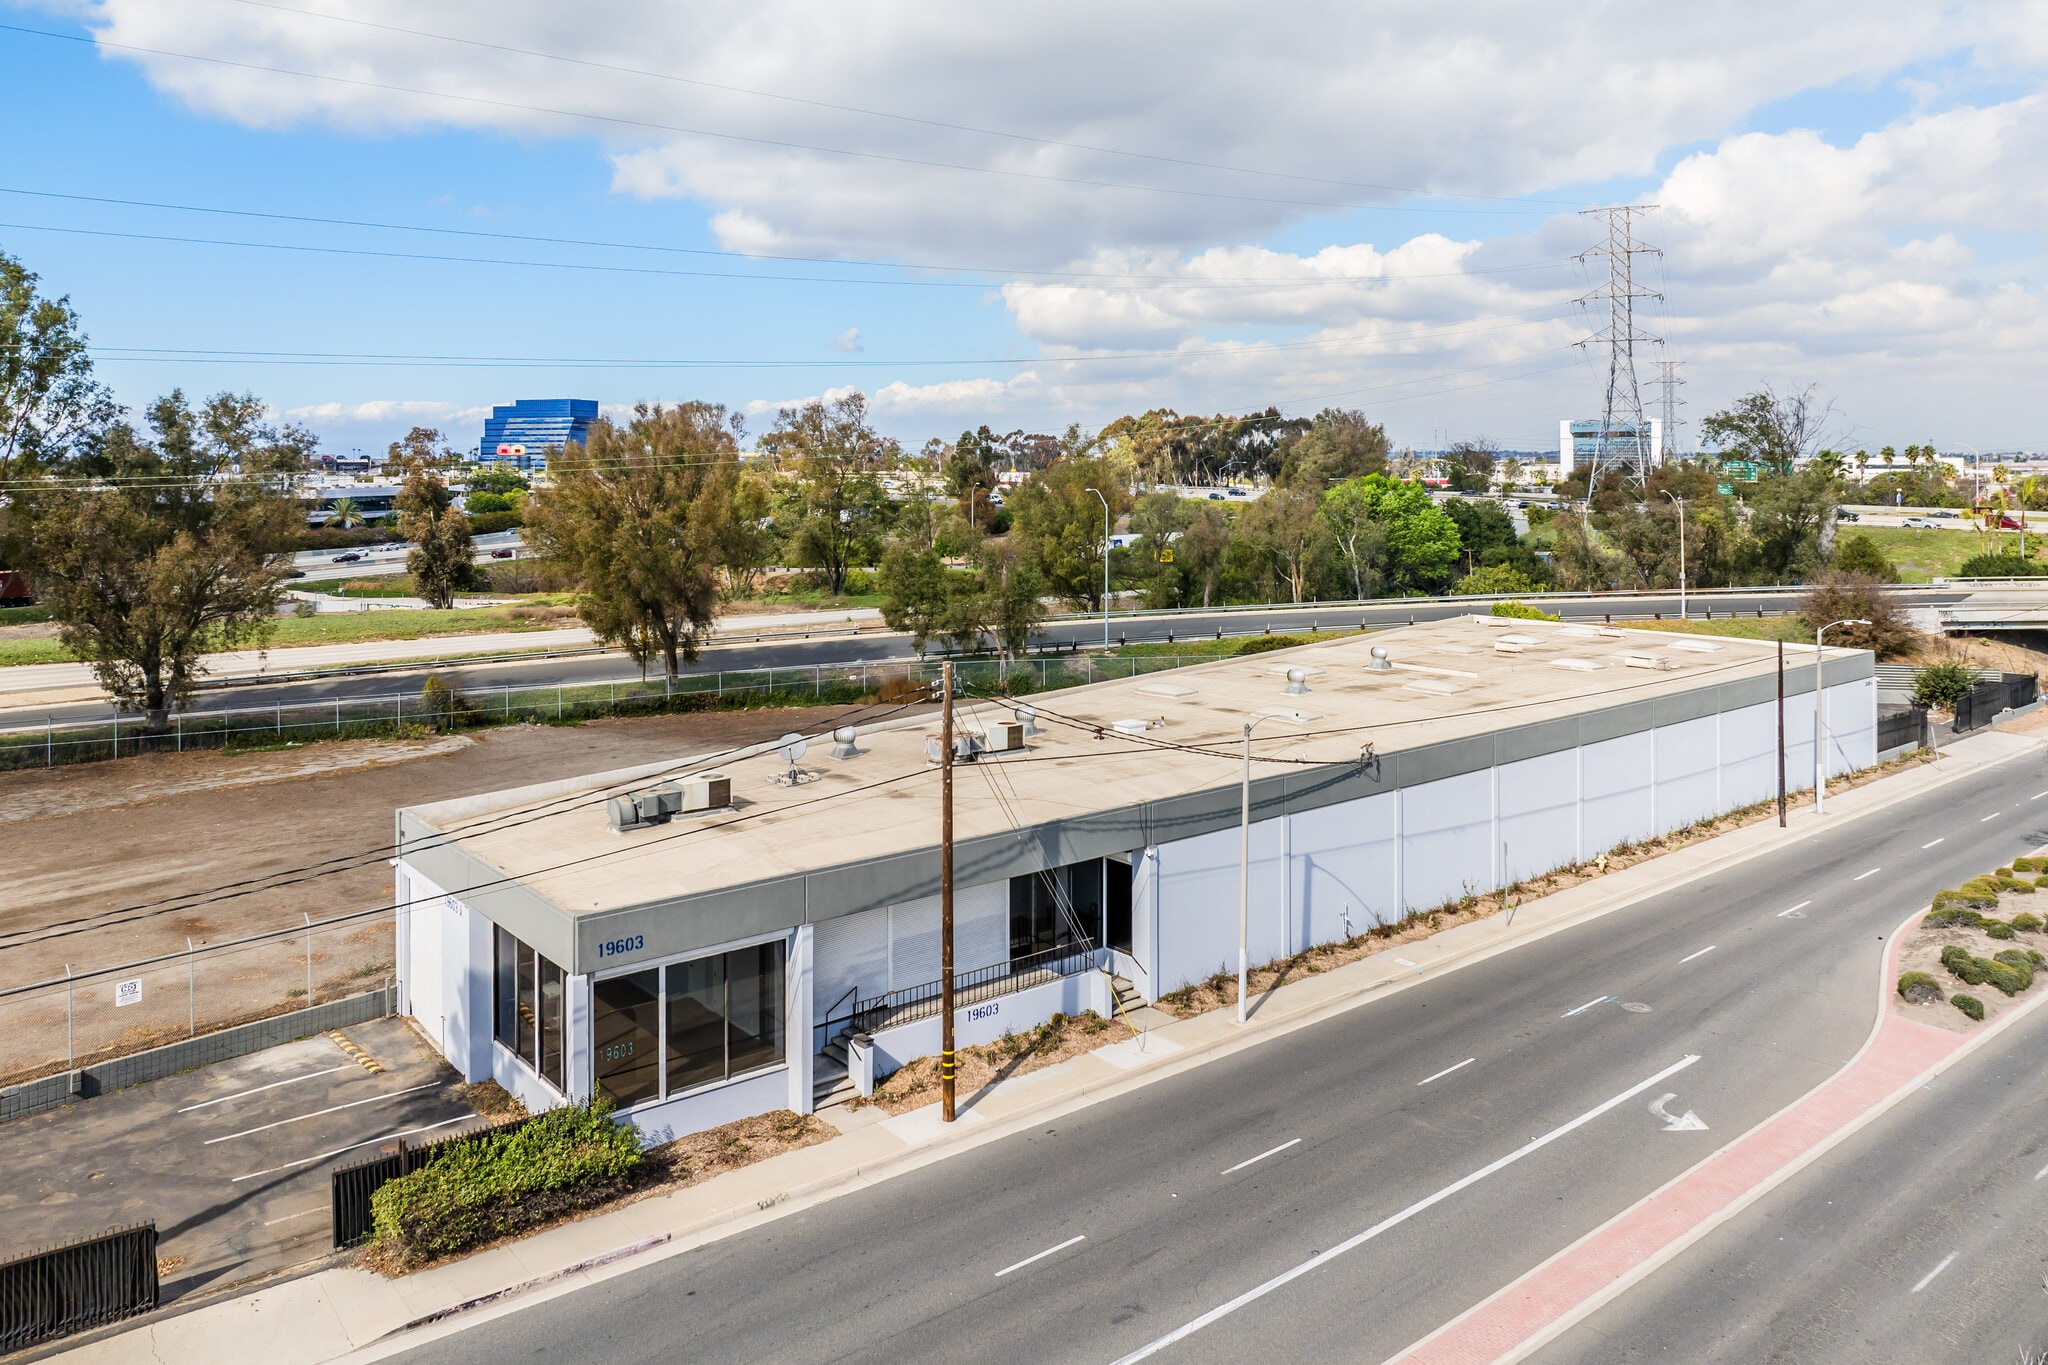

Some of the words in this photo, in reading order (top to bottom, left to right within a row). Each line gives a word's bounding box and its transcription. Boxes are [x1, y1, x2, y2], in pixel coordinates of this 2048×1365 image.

[598, 934, 644, 958] 19603
[967, 1002, 999, 1022] 19603
[599, 1041, 634, 1063] 19603
